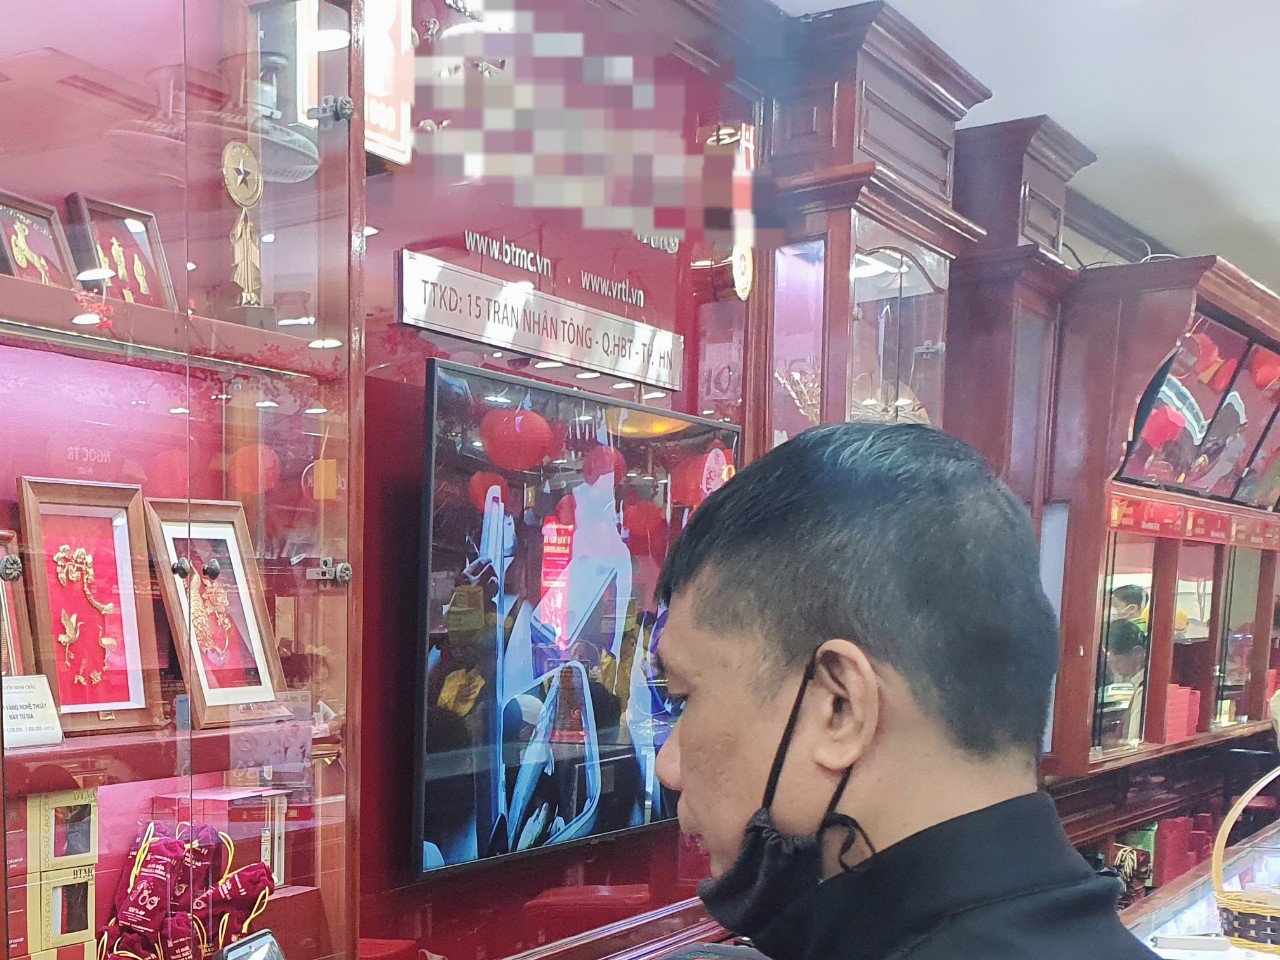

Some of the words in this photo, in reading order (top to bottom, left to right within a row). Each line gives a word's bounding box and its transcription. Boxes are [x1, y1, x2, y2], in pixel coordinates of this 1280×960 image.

[464, 229, 552, 278] www.btmc.vn
[580, 270, 645, 308] www.vrtl.vn
[421, 278, 463, 313] TTKD:
[466, 293, 482, 320] 15
[523, 309, 558, 341] NHÂN
[561, 317, 592, 349] TÔNG
[602, 331, 633, 359] Q.HBT
[658, 348, 673, 370] HN
